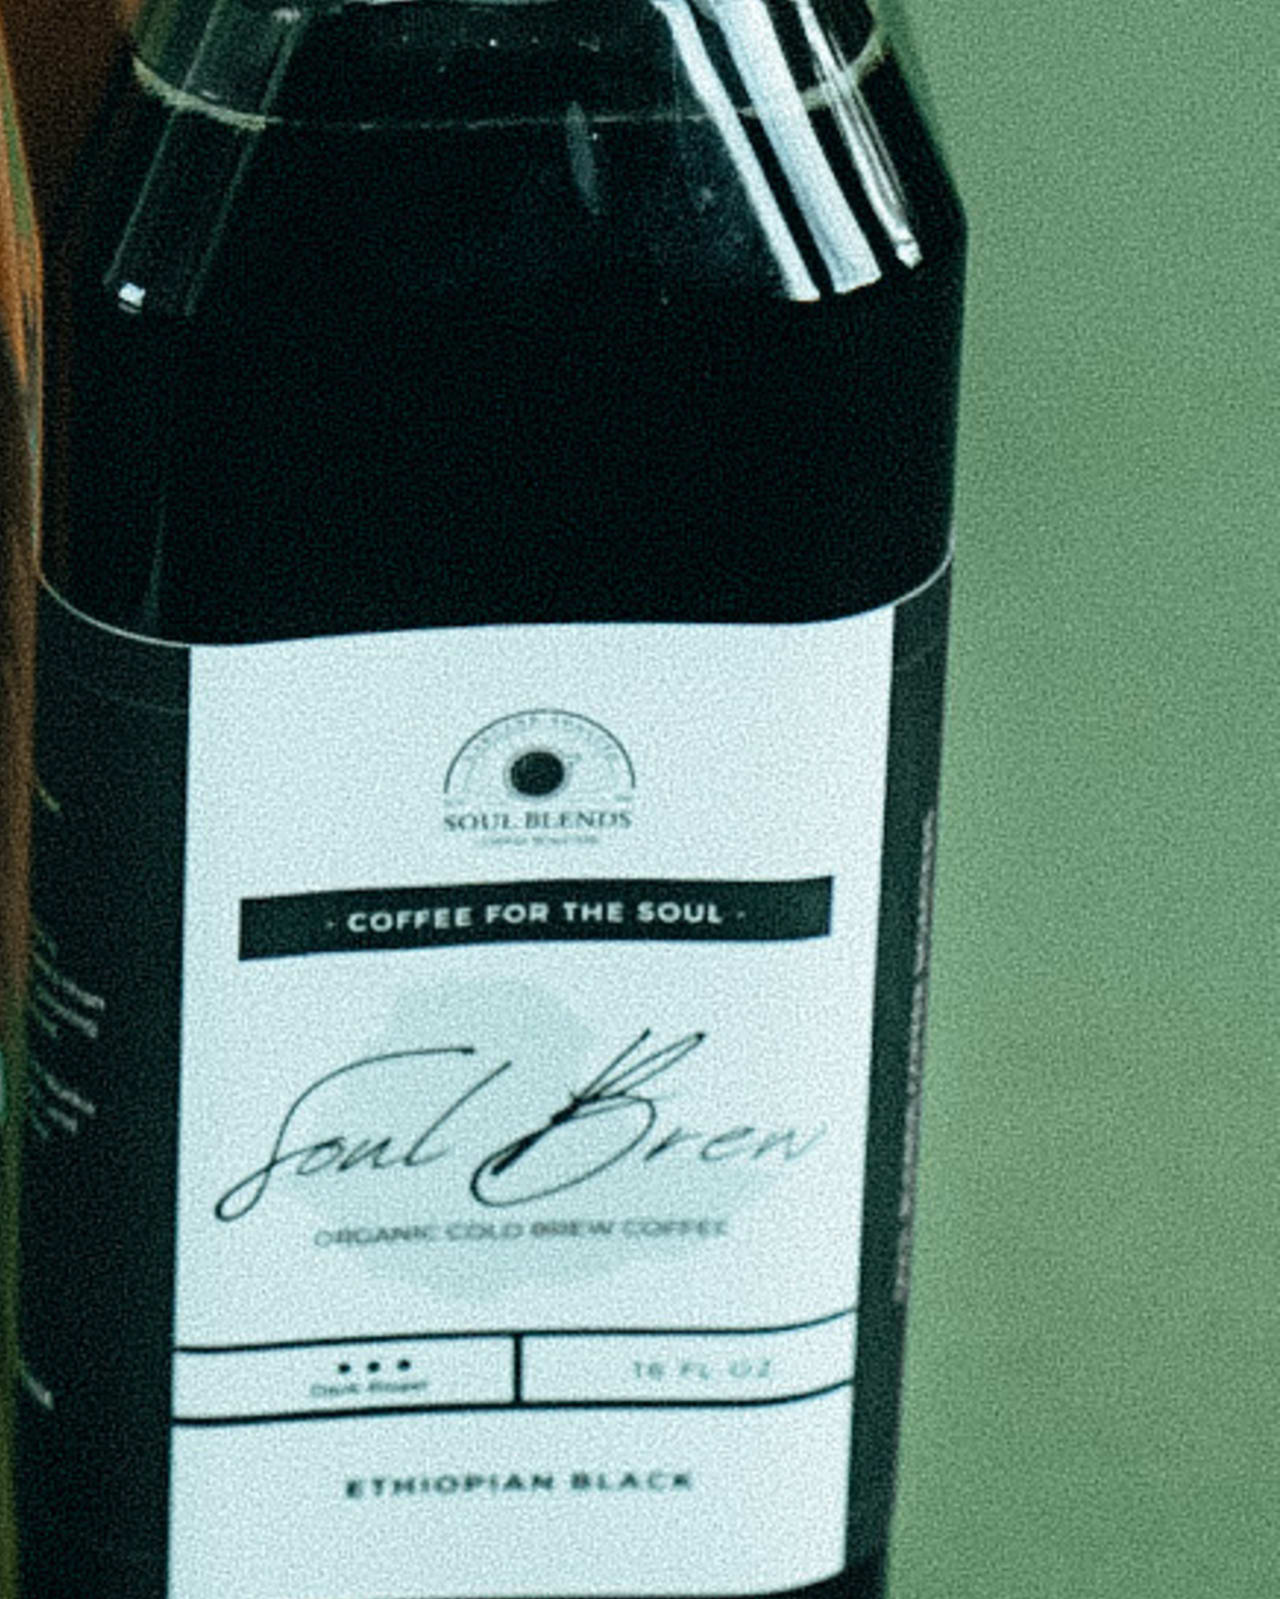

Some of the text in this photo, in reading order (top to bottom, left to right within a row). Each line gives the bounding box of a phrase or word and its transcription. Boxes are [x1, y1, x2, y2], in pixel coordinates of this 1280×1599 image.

[444, 810, 634, 832] SOUL BLENDS
[347, 901, 724, 933] COFFEE FOR THE SOUL
[214, 1046, 513, 1223] Soul
[469, 1027, 829, 1208] Brew
[313, 1217, 729, 1249] ORGANIC COLD BREW COFFEE
[679, 1360, 710, 1381] FL
[345, 1471, 694, 1499] ETHIOPIAN BLACK
